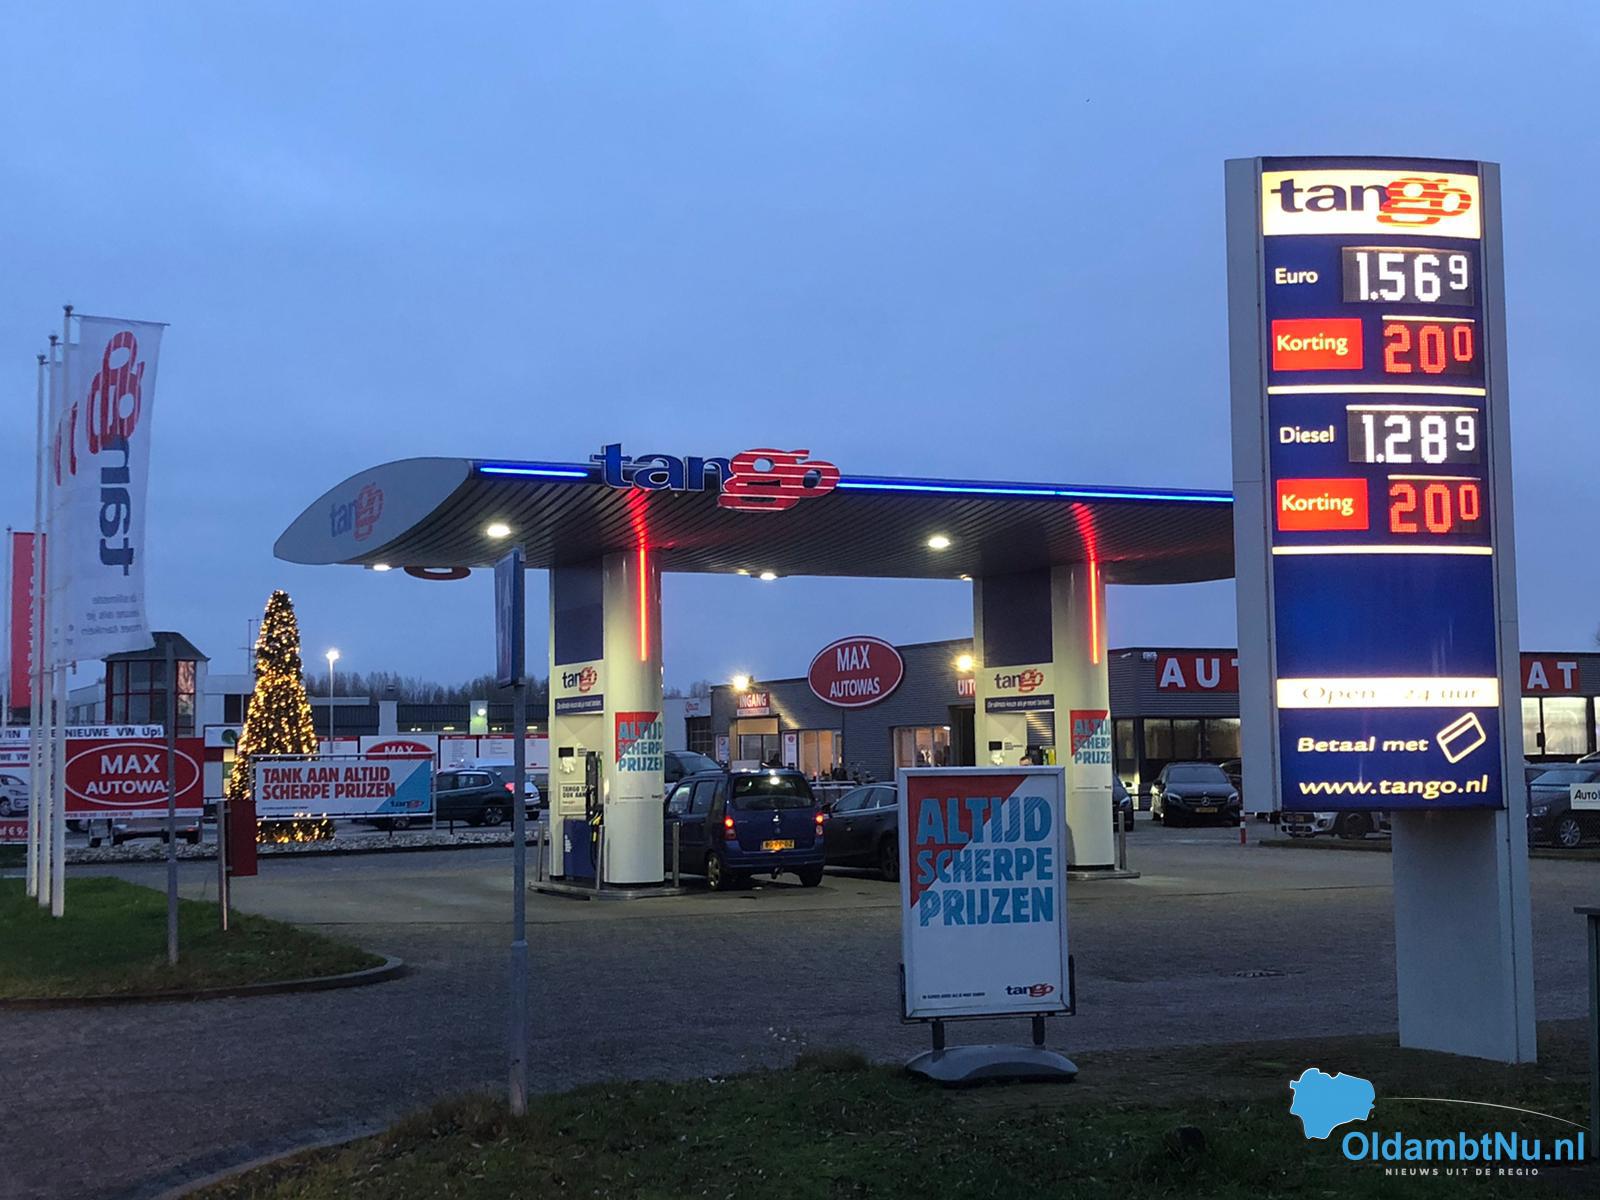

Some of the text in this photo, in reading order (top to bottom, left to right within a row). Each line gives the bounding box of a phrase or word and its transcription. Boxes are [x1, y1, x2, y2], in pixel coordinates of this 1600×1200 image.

[1271, 178, 1472, 227] tango
[1274, 268, 1319, 285] Euro
[1276, 333, 1349, 356] Korting
[1279, 425, 1335, 444] Diesel
[590, 443, 841, 513] tango
[329, 481, 384, 542] tango
[1281, 493, 1354, 517] Korting
[837, 645, 870, 672] MAX
[562, 666, 598, 693] tango
[829, 677, 880, 698] AUTOWAS
[994, 669, 1044, 693] tango
[740, 693, 767, 707] INGANG
[65, 728, 109, 738] NIEUWE
[116, 727, 136, 736] VW
[1297, 736, 1429, 752] Betaal met
[101, 754, 160, 775] MAX
[263, 766, 390, 784] TANK AAN ALTIJD
[262, 782, 396, 800] SCHERPE PRIJZEN
[1299, 774, 1488, 799] www.tango.nl
[917, 796, 1053, 845] ALTIJD
[917, 847, 1054, 884] SCHERPE
[919, 887, 1054, 927] PRIJZEN
[1006, 983, 1055, 998] tango
